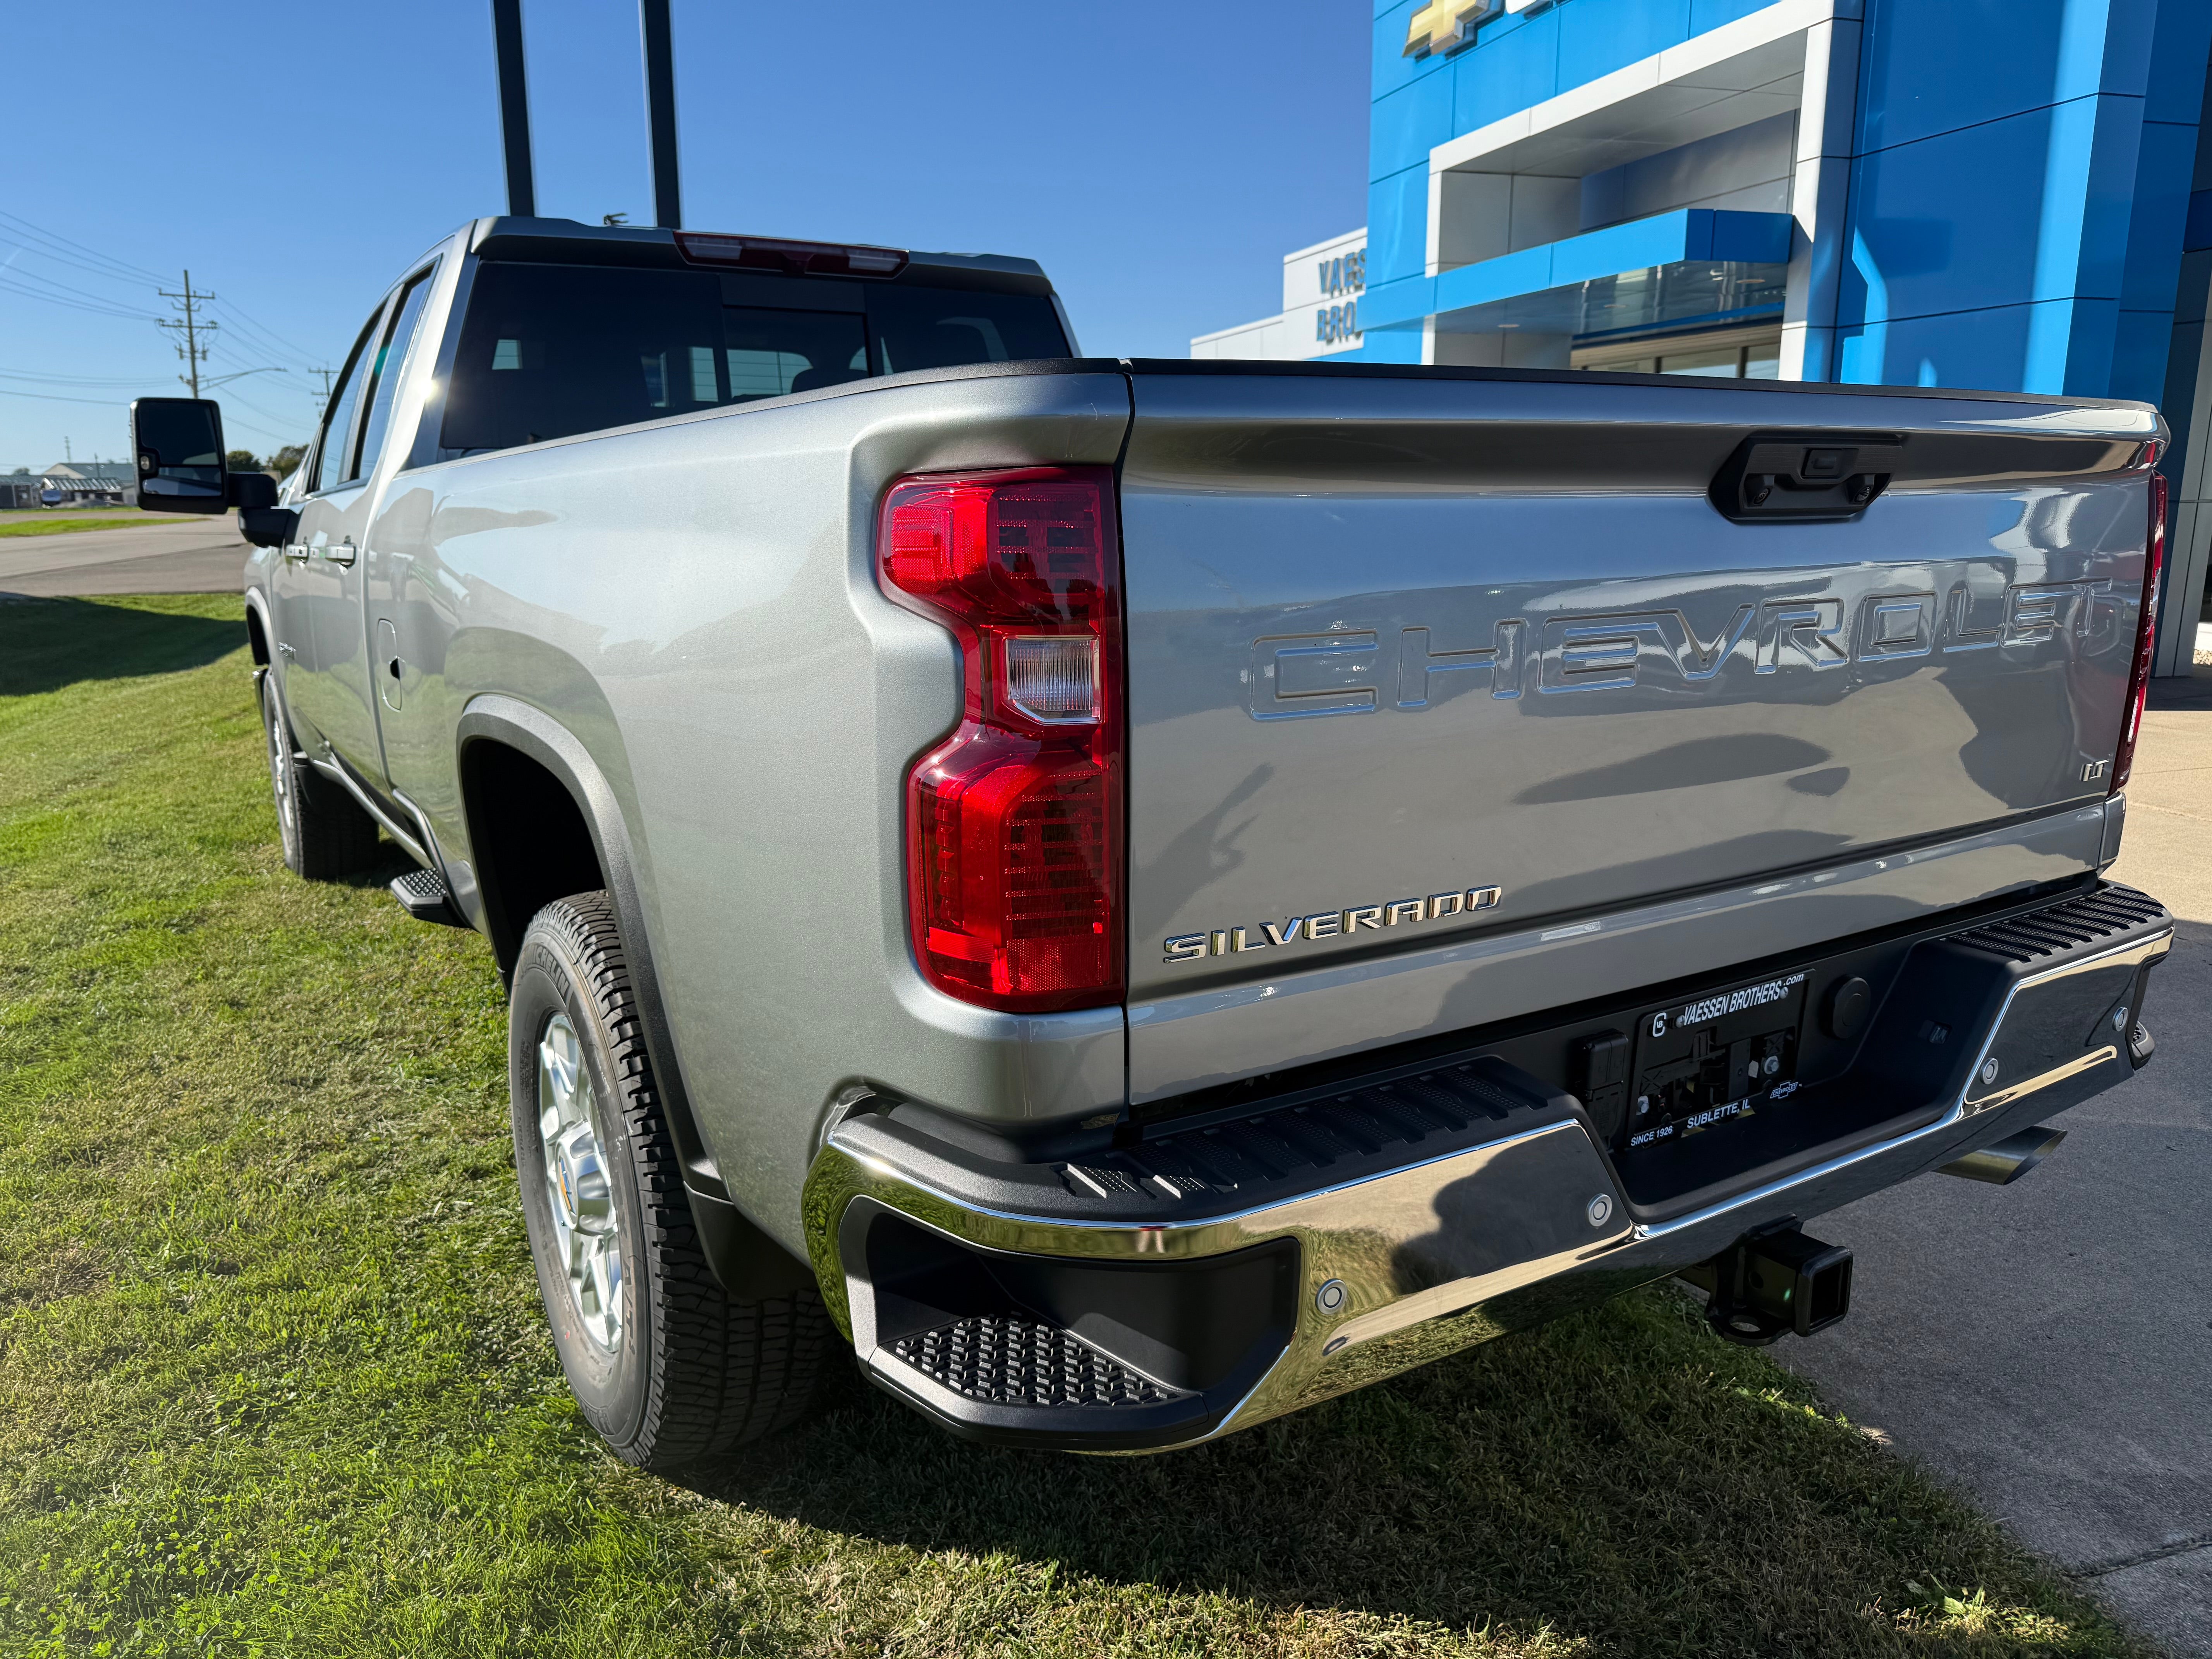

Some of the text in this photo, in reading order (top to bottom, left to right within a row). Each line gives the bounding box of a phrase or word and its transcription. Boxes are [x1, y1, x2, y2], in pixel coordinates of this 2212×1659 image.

[1317, 301, 1355, 341] BRO
[1249, 576, 2112, 721] CHEVROLET
[2079, 759, 2110, 781] LT
[1163, 884, 1502, 963] SILVERADO
[1684, 994, 1730, 1025] VAESSEN
[1729, 980, 1782, 1013] BROTHERS
[1687, 1099, 1750, 1129] SUBLETTE, IL
[1631, 1125, 1673, 1146] SINCE 1926
